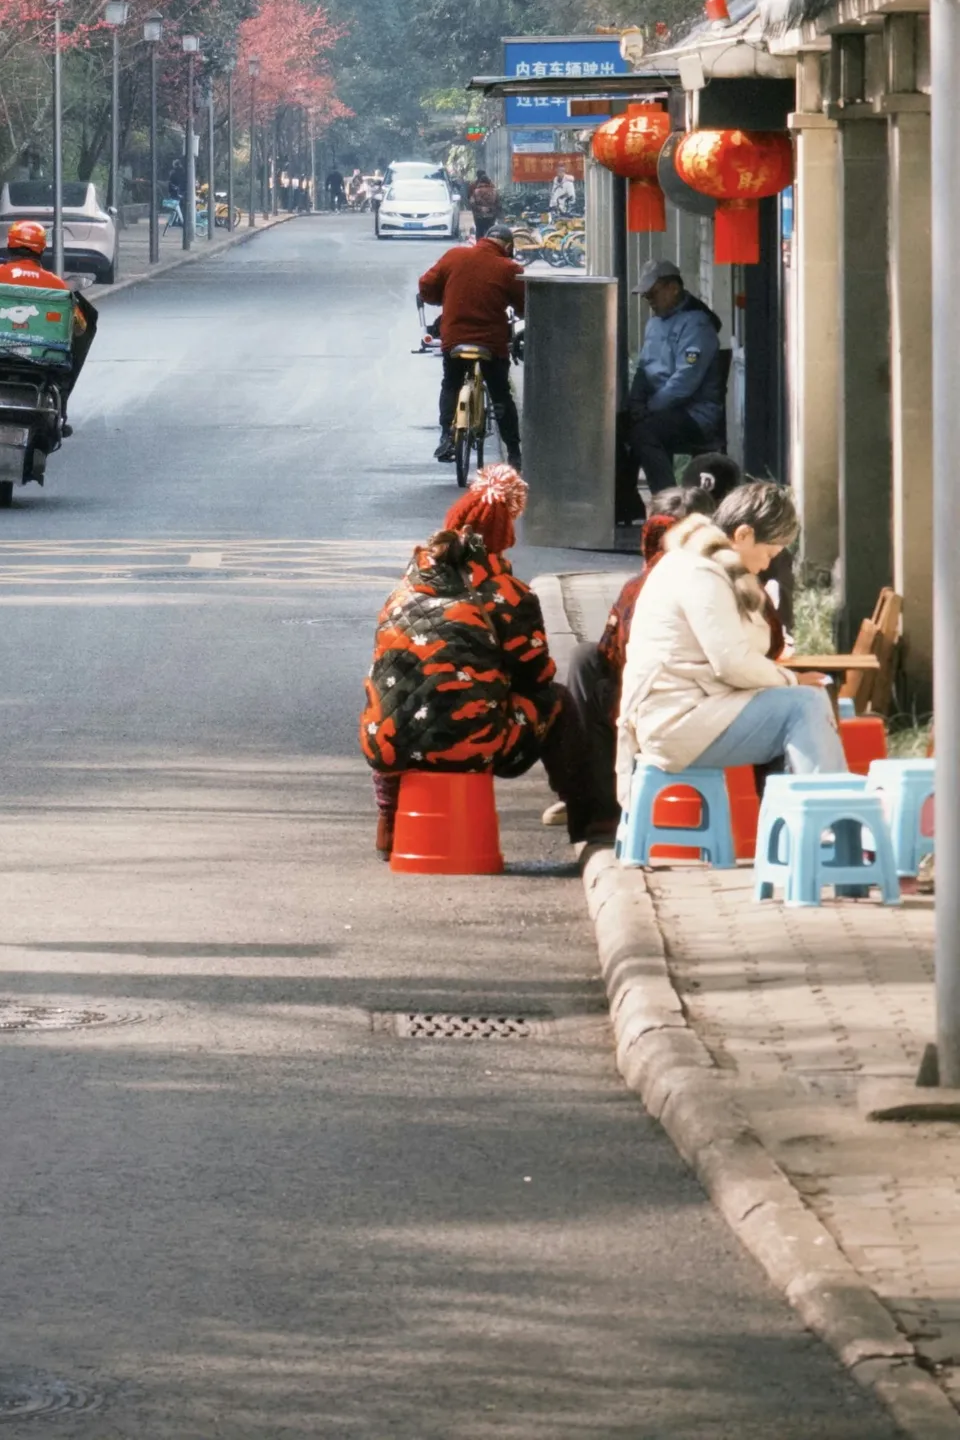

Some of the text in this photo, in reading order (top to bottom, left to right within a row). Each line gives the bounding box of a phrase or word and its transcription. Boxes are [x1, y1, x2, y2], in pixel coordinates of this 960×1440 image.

[516, 61, 615, 77] 内有车辆驶出
